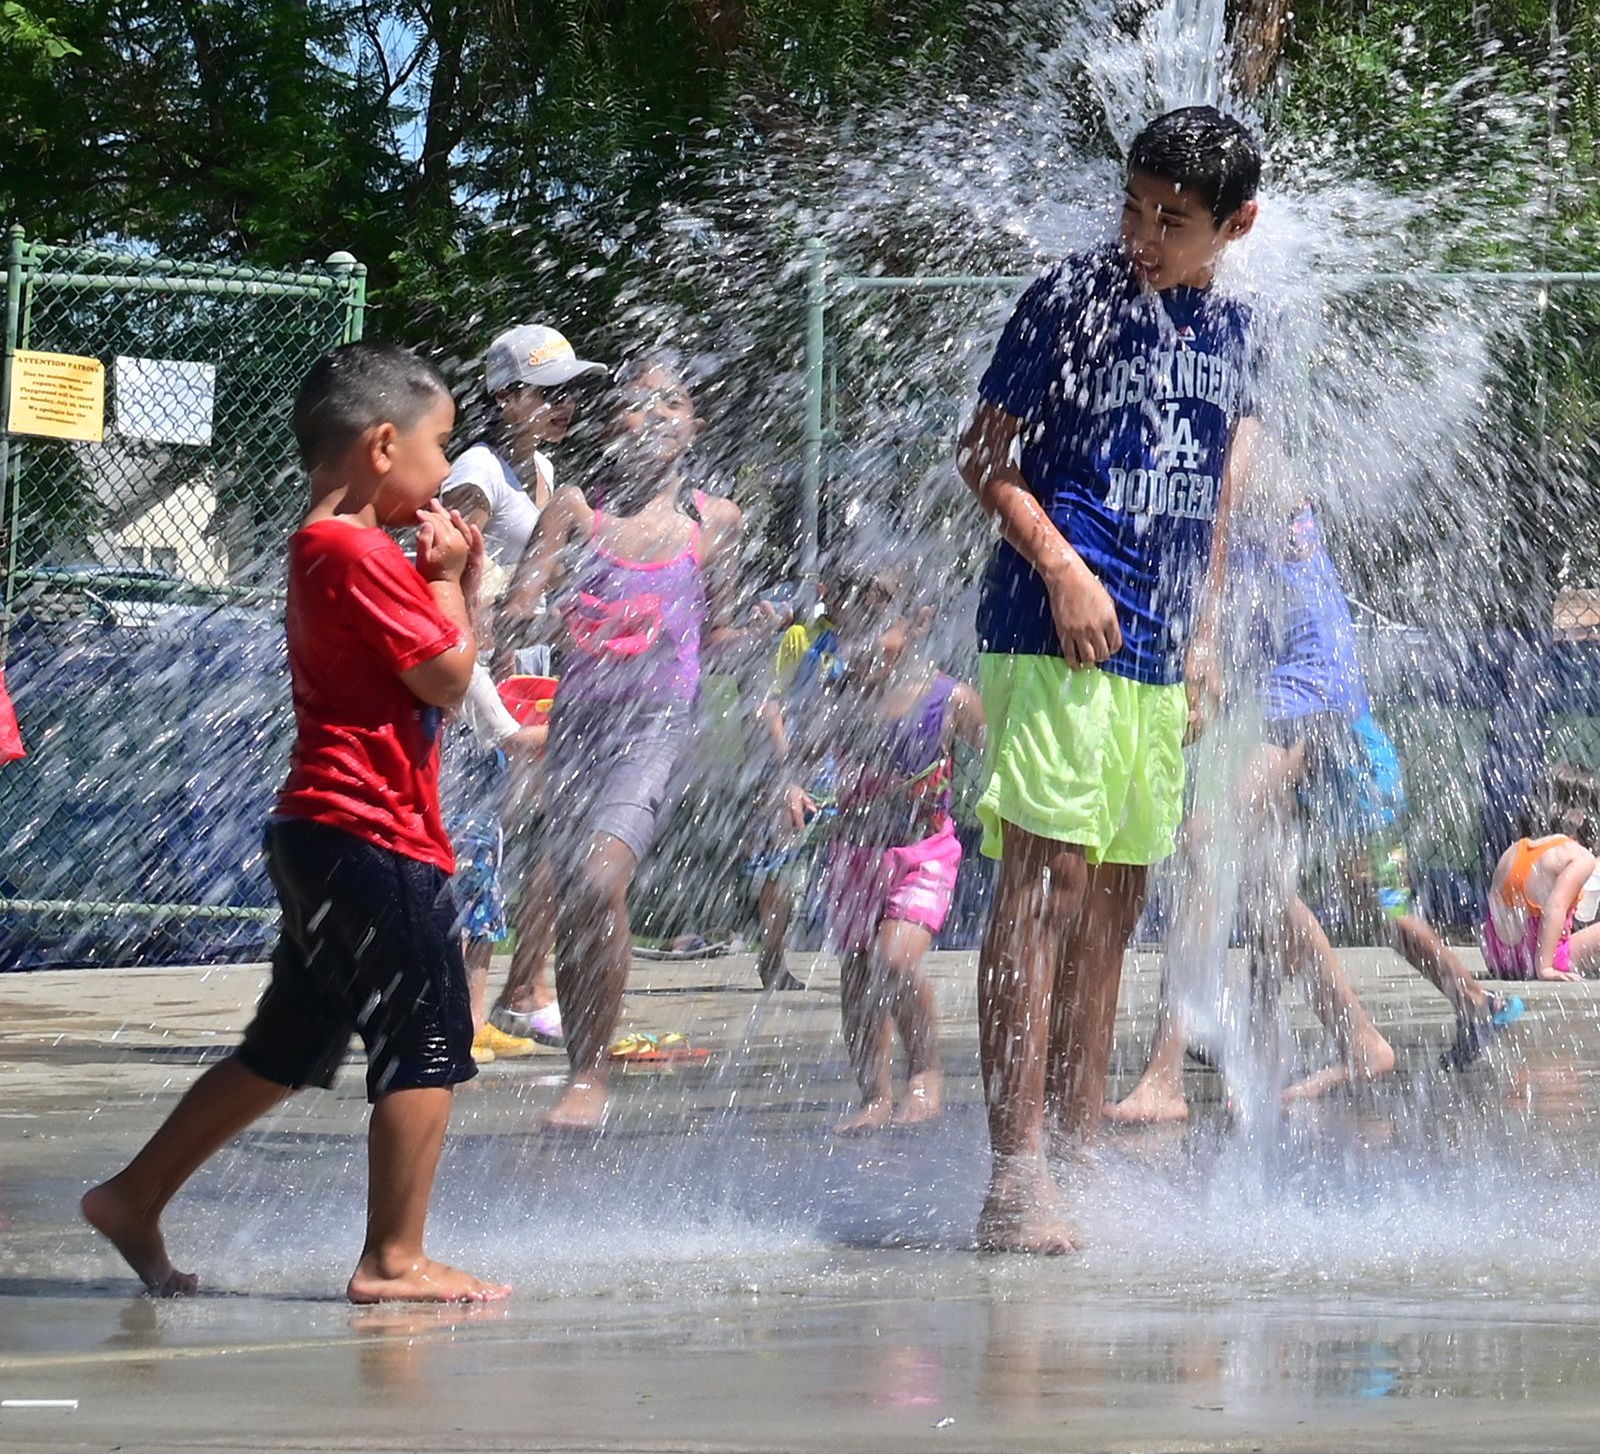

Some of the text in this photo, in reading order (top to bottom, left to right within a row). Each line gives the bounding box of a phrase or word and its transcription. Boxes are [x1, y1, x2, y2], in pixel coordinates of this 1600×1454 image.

[18, 357, 100, 373] ATTENTION PATRONS
[20, 387, 57, 396] Playground
[1092, 350, 1240, 416] LOS ANGEL
[1163, 403, 1199, 469] LA
[1104, 468, 1221, 521] DODGER
